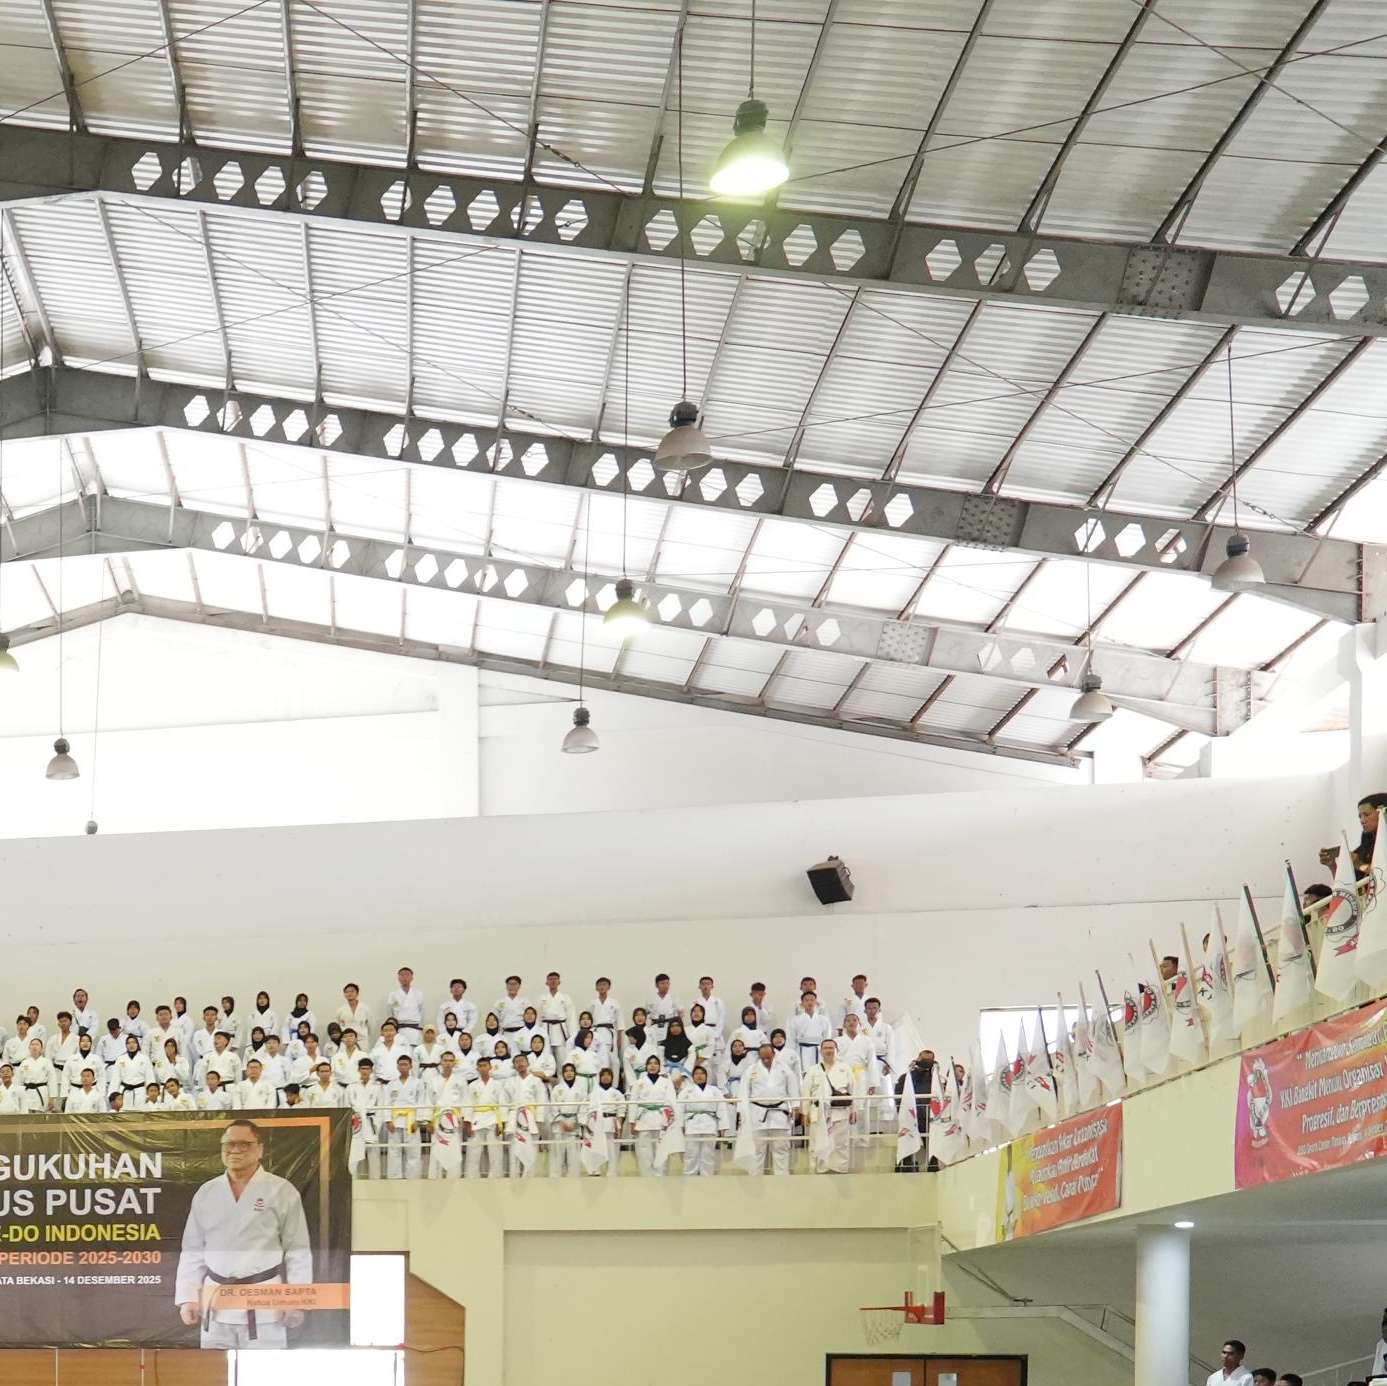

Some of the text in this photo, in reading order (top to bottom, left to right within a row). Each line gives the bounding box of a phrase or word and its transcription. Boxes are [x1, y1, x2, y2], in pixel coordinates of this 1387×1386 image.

[45, 1187, 162, 1216] PUSAT
[45, 1224, 162, 1242] INDONESIA
[78, 1250, 162, 1265] 2025-2030
[16, 1276, 55, 1286] BEKASI
[63, 1276, 75, 1285] 14
[77, 1275, 136, 1285] DESEMBER
[137, 1275, 162, 1285] 2025
[284, 1287, 317, 1296] SAPTA
